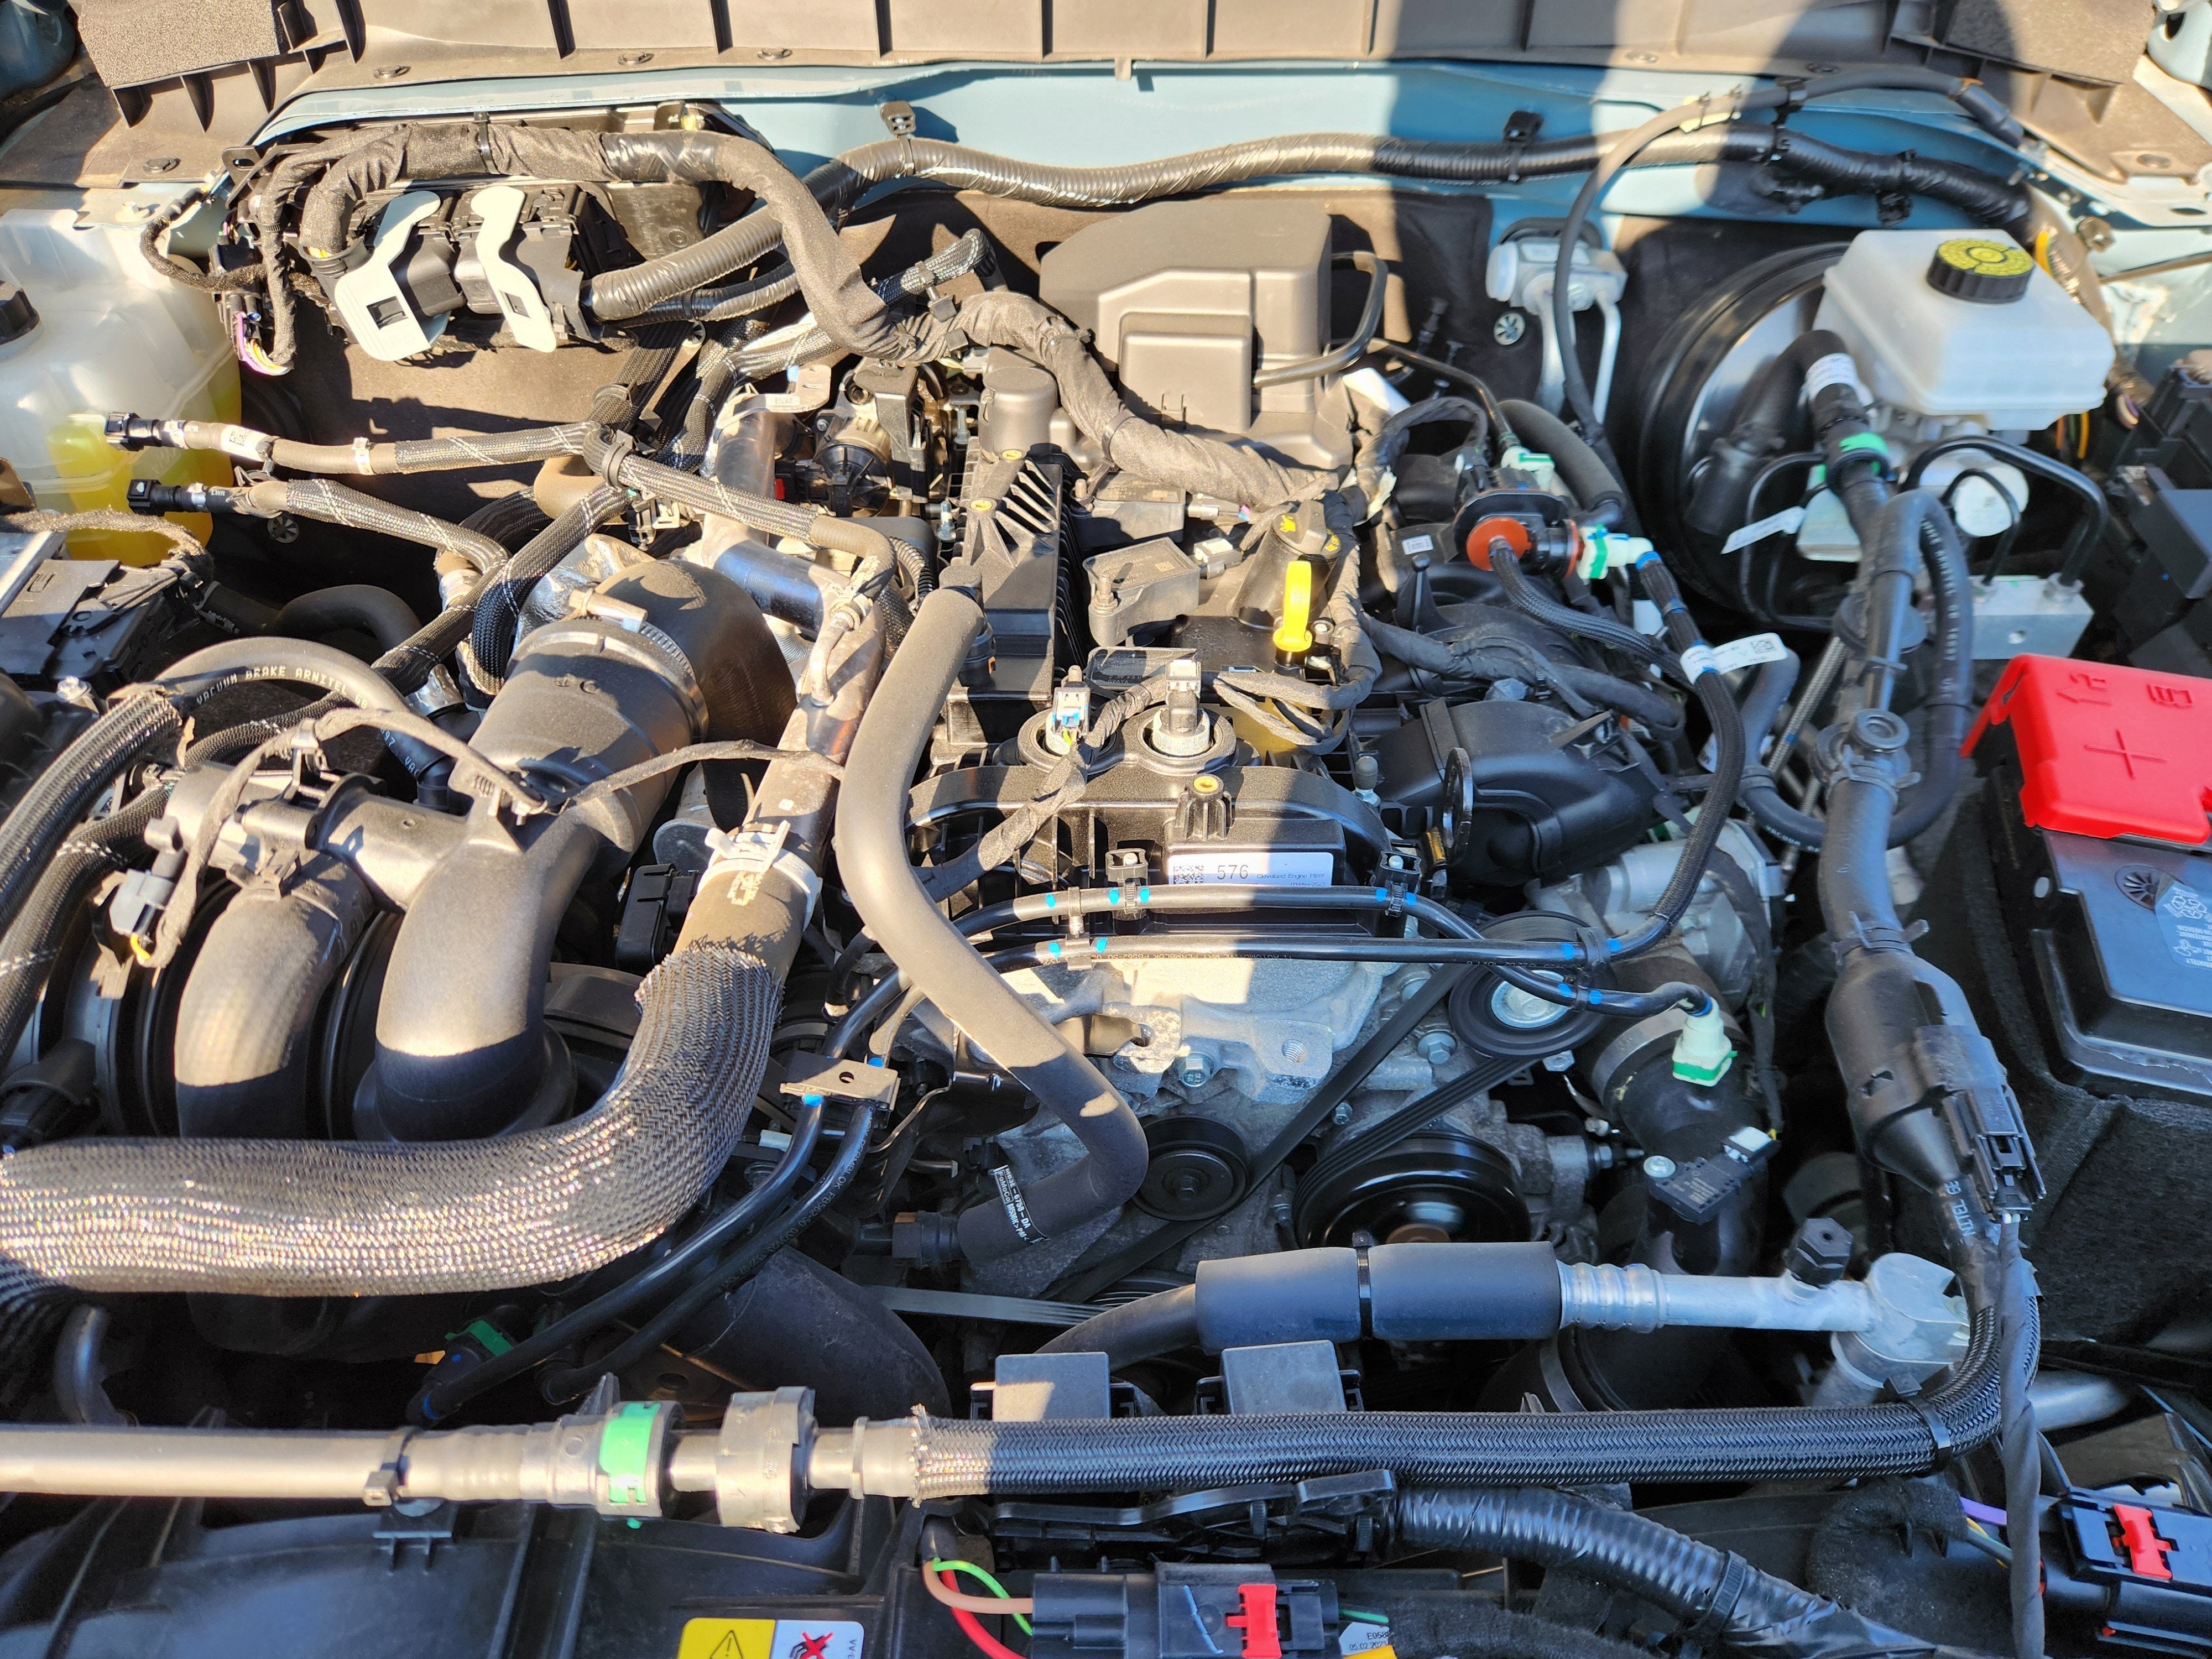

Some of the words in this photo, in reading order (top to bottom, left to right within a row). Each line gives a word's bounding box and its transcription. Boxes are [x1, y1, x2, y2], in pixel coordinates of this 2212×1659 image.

[196, 673, 238, 706] VACUUM
[246, 665, 286, 680] BRAKE
[295, 666, 347, 696] ARNITEL
[1217, 864, 1249, 880] 576
[997, 1172, 1011, 1202] FoMoCo
